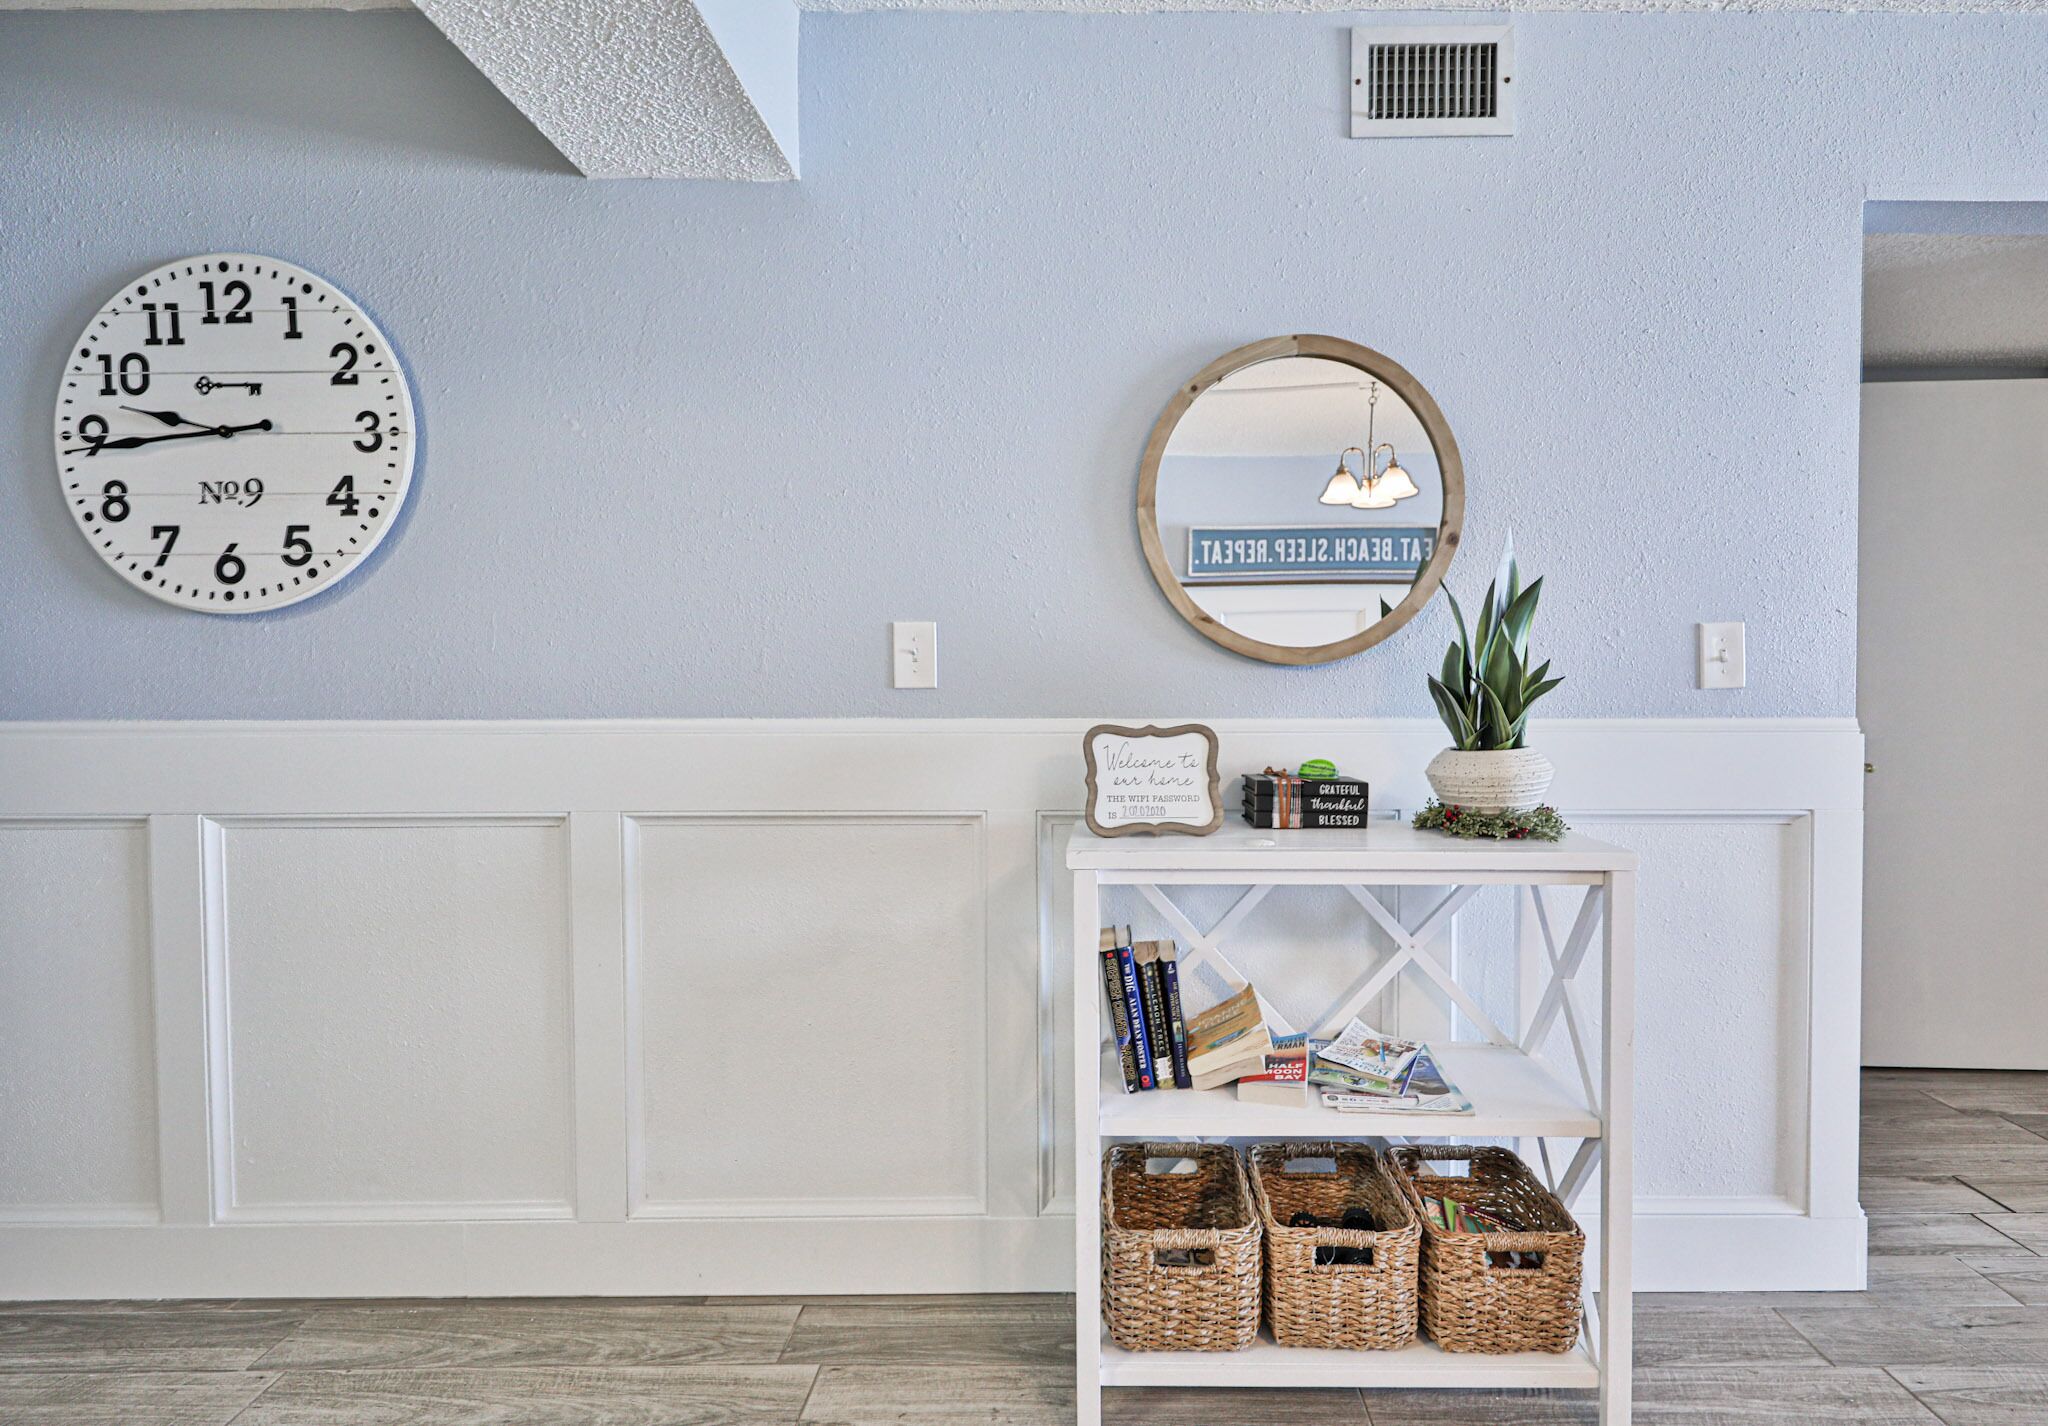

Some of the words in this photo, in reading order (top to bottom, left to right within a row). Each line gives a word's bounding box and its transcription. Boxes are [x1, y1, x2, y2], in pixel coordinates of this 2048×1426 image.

[199, 280, 252, 324] 12
[281, 296, 303, 340] 1
[142, 302, 185, 346] 11
[98, 352, 151, 396] 10
[329, 342, 359, 386] 2
[78, 414, 109, 457] 9
[352, 410, 383, 453] 3
[101, 480, 131, 523] 8
[325, 475, 360, 517] 4
[151, 525, 181, 567] 7
[215, 543, 246, 585] 6
[281, 525, 313, 567] 5
[1103, 741, 1176, 771] Welcome
[1178, 752, 1199, 768] to
[1113, 776, 1142, 786] our
[1147, 769, 1195, 786] home
[1319, 784, 1360, 796] GRATEFUL
[1107, 795, 1126, 803] THE
[1128, 795, 1150, 803] WIFI
[1152, 795, 1200, 803] PASSWORD
[1310, 797, 1366, 812] thankful
[1318, 814, 1360, 826] BLESSED
[1124, 975, 1136, 993] DIG
[1128, 998, 1140, 1018] ALAN
[1151, 993, 1162, 1024] LEMON
[1157, 1028, 1166, 1052] TREE
[1132, 1019, 1143, 1040] DEAN
[1136, 1040, 1147, 1069] FOSTER
